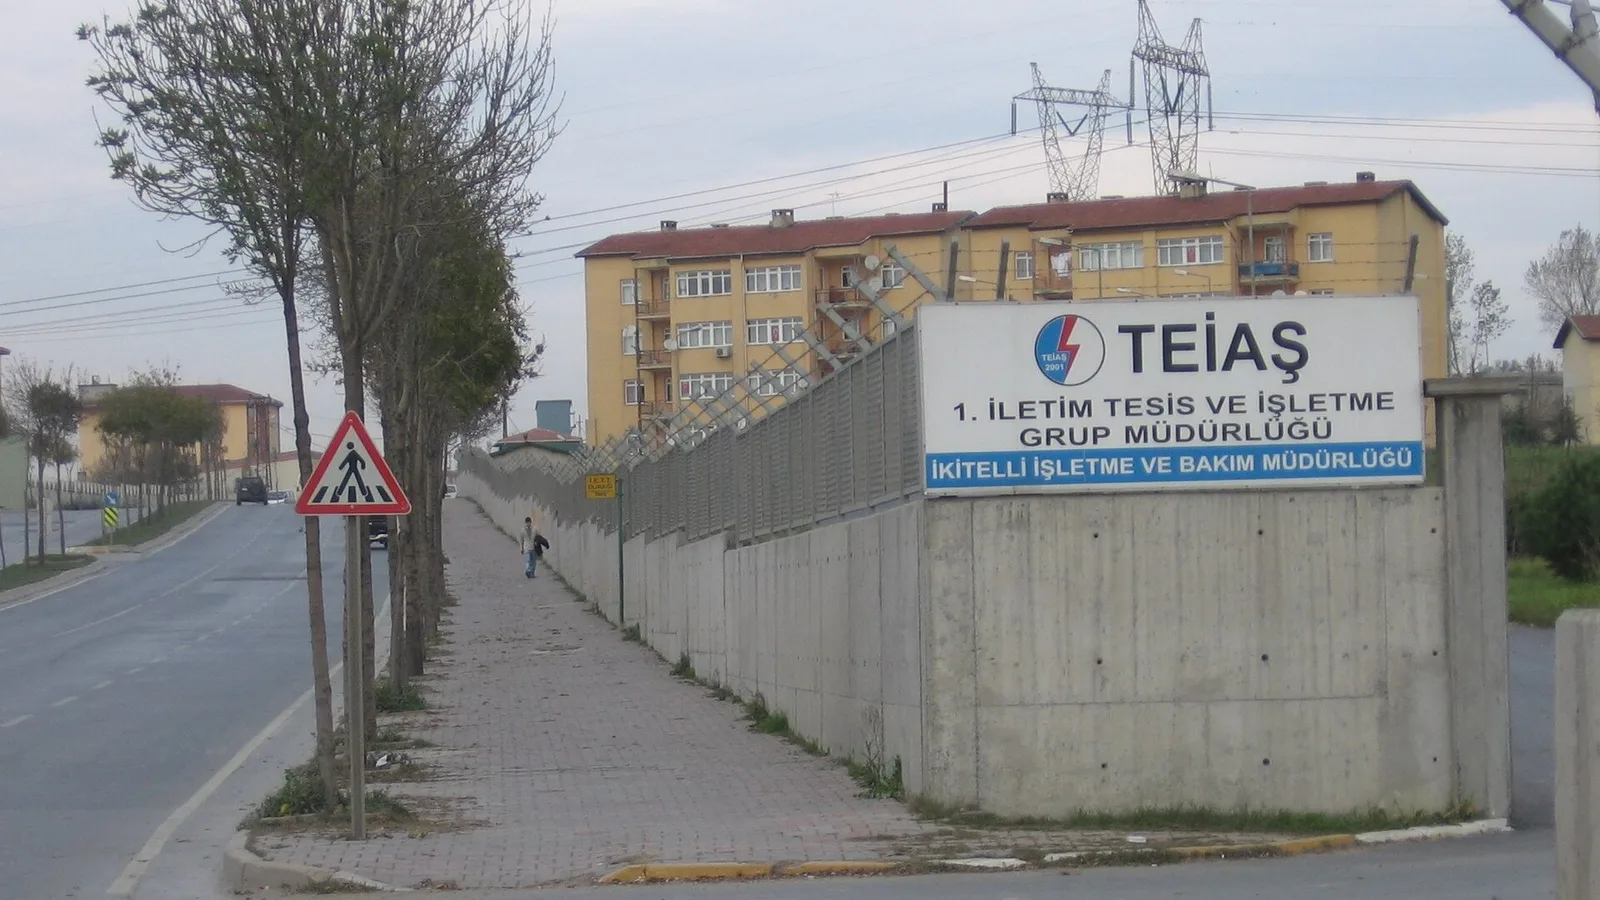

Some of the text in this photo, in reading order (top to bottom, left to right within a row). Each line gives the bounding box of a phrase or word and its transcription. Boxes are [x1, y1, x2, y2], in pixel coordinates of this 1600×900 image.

[1118, 311, 1309, 384] TEİAŞ
[1045, 363, 1064, 371] 2001
[953, 390, 1395, 421] 1. İLETİM TESİS VE İŞLETME
[1019, 416, 1333, 447] GRUP MÜDÜRLÜĞÜ
[931, 446, 1413, 481] İKİTELLİ İŞLETME VE BAKIM MÜDÜRLÜĞÜ
